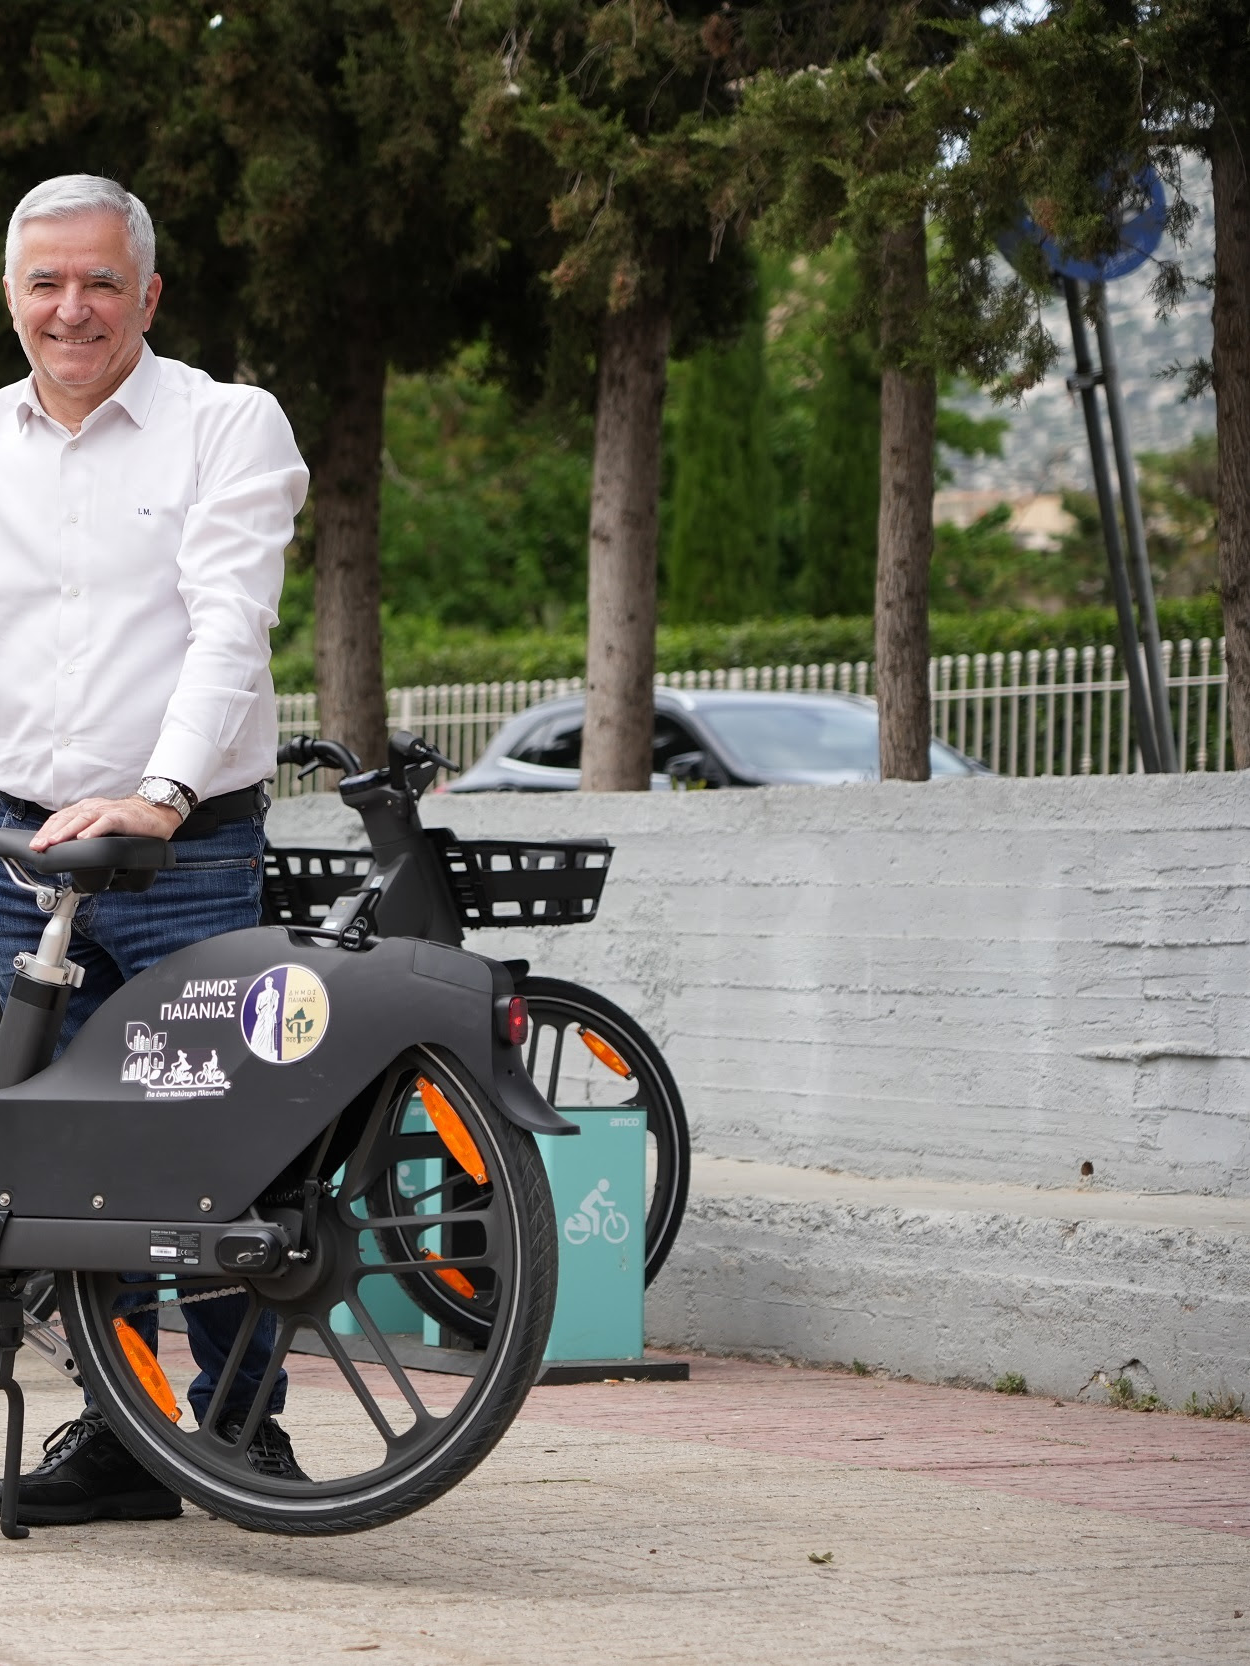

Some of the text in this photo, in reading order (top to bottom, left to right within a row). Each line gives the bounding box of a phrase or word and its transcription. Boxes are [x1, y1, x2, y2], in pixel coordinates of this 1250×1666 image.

[182, 980, 238, 998] ΔΗΜΟΣ
[160, 1001, 236, 1020] ΠΑΙΑΝΙΑΣ
[610, 1118, 639, 1126] amco
